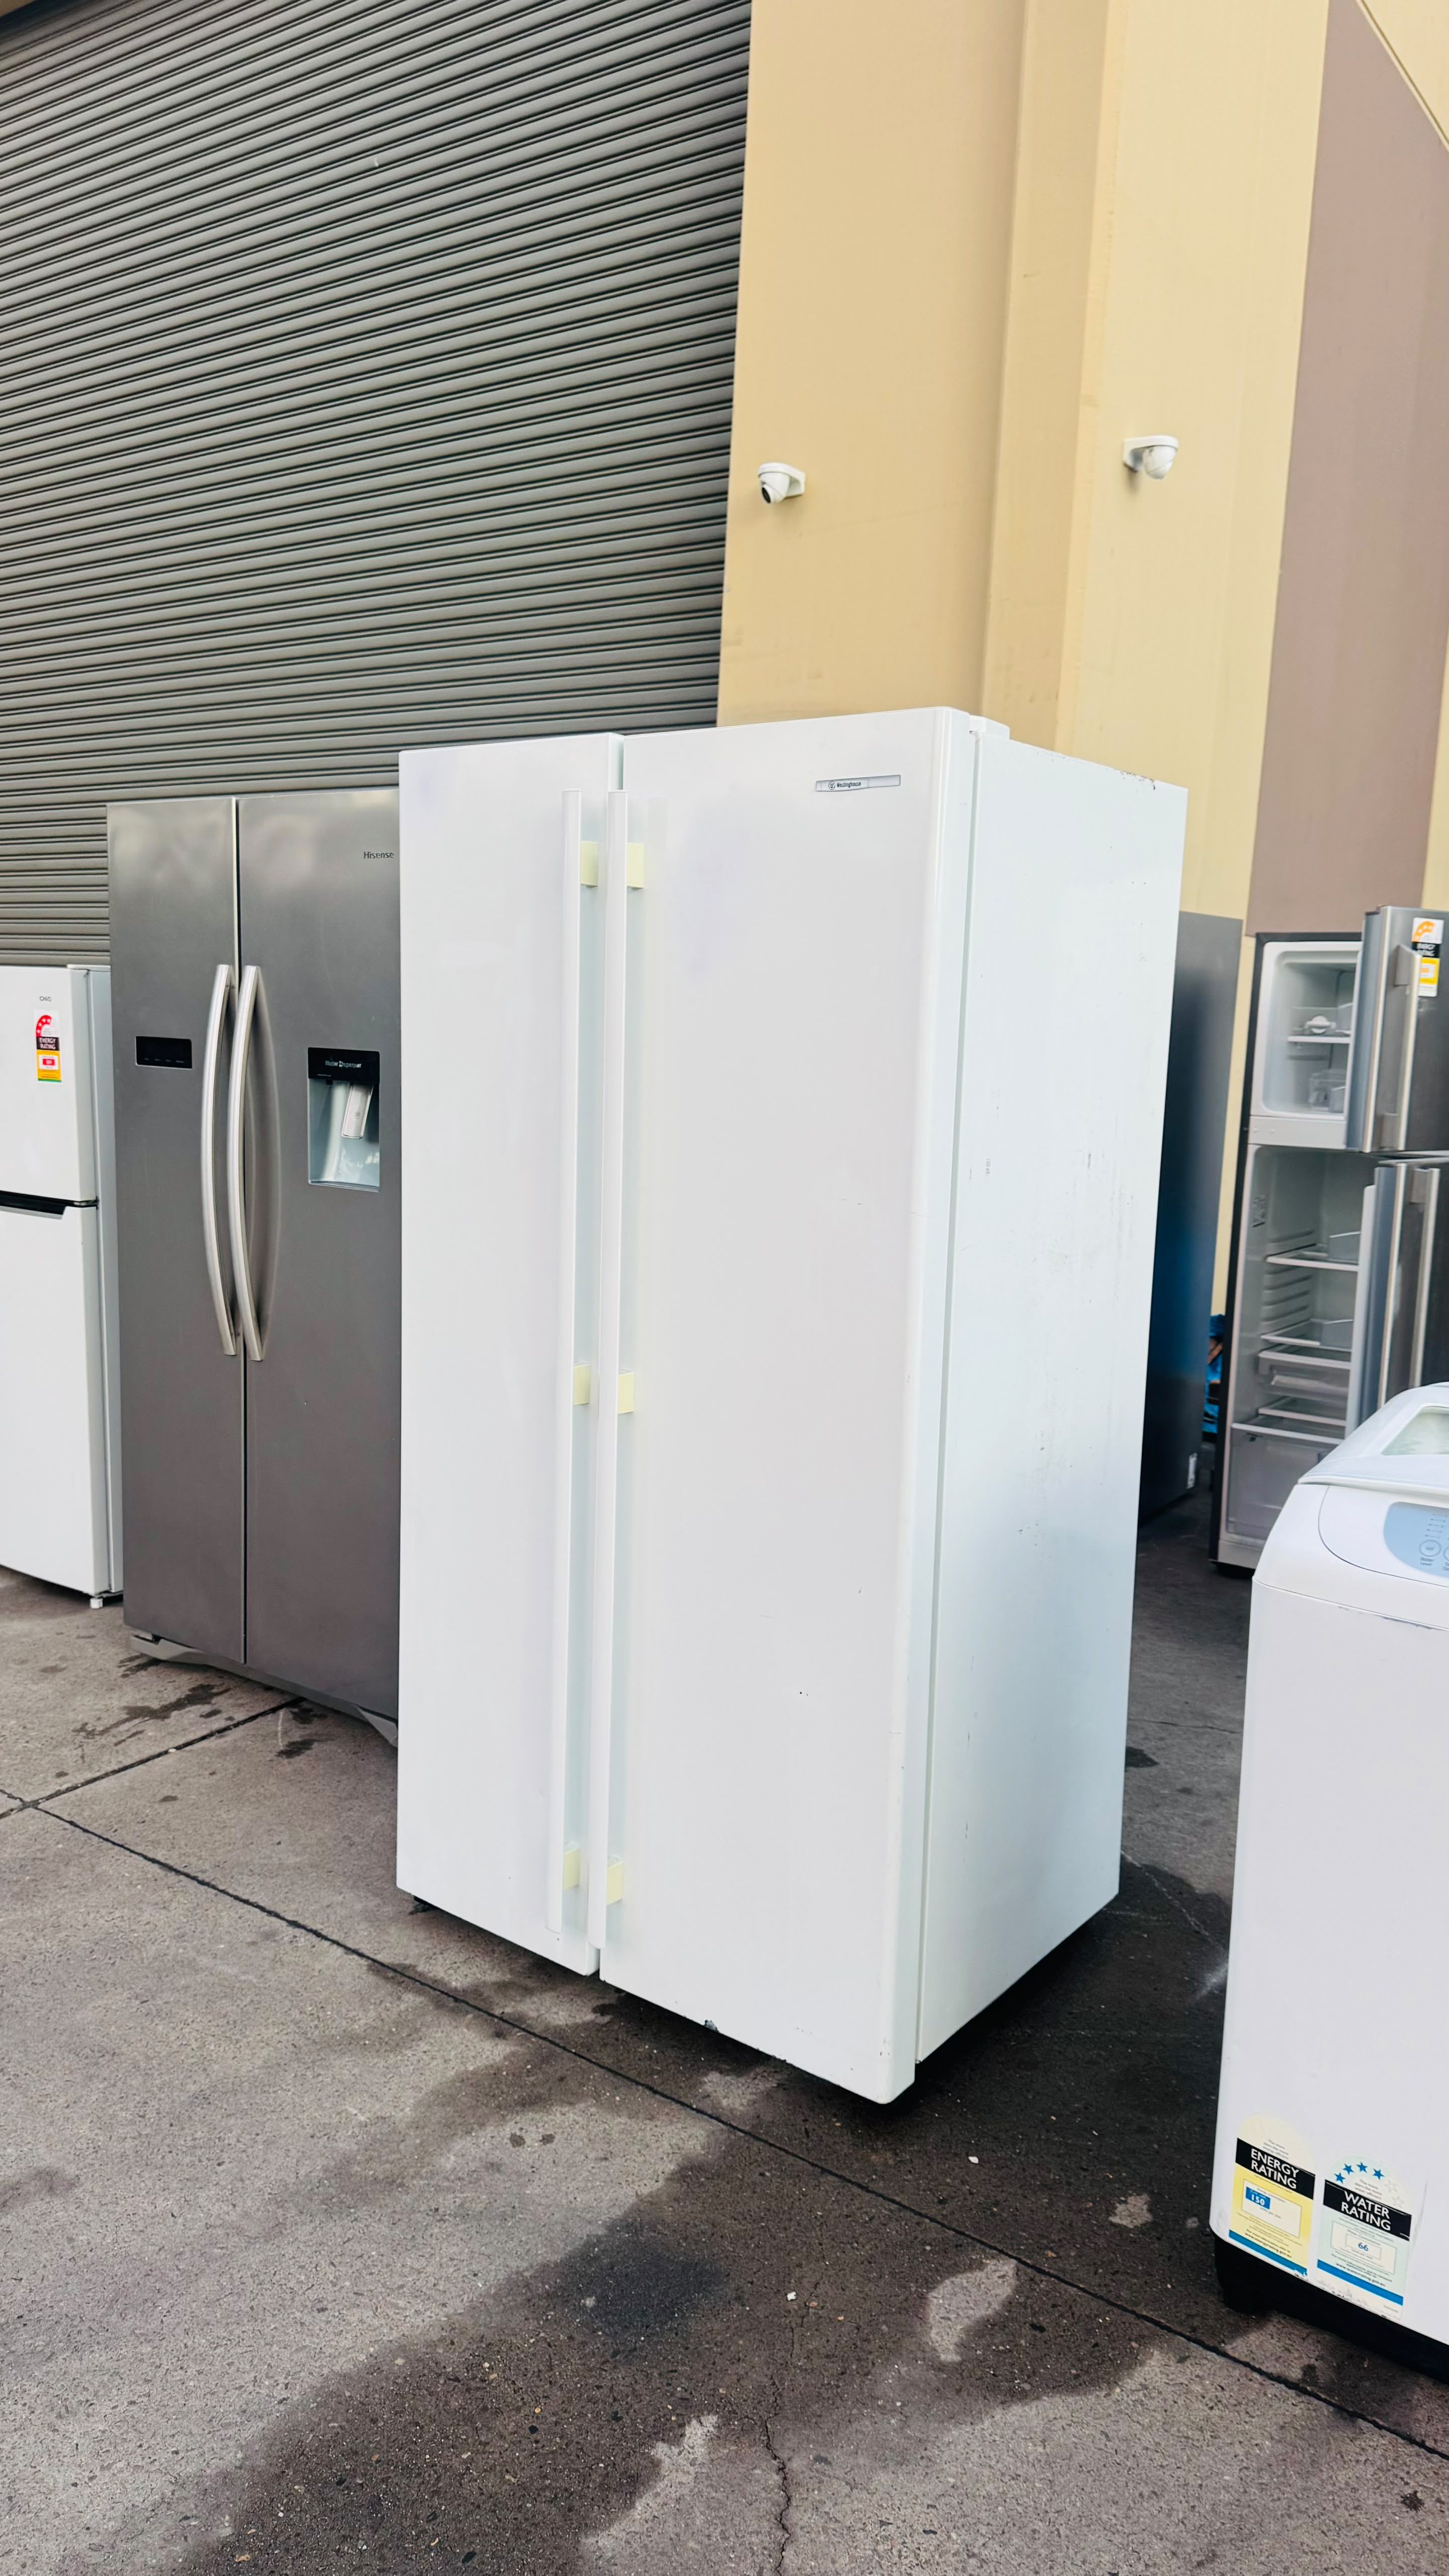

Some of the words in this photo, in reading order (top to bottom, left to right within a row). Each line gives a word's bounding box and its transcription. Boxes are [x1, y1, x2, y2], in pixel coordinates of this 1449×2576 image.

[1251, 2148, 1299, 2178] ENERGY
[1251, 2160, 1297, 2189] RATING
[1251, 2194, 1265, 2206] 150
[1344, 2191, 1390, 2219] WATER
[1341, 2201, 1391, 2231] RATING
[1358, 2242, 1369, 2251] 66
